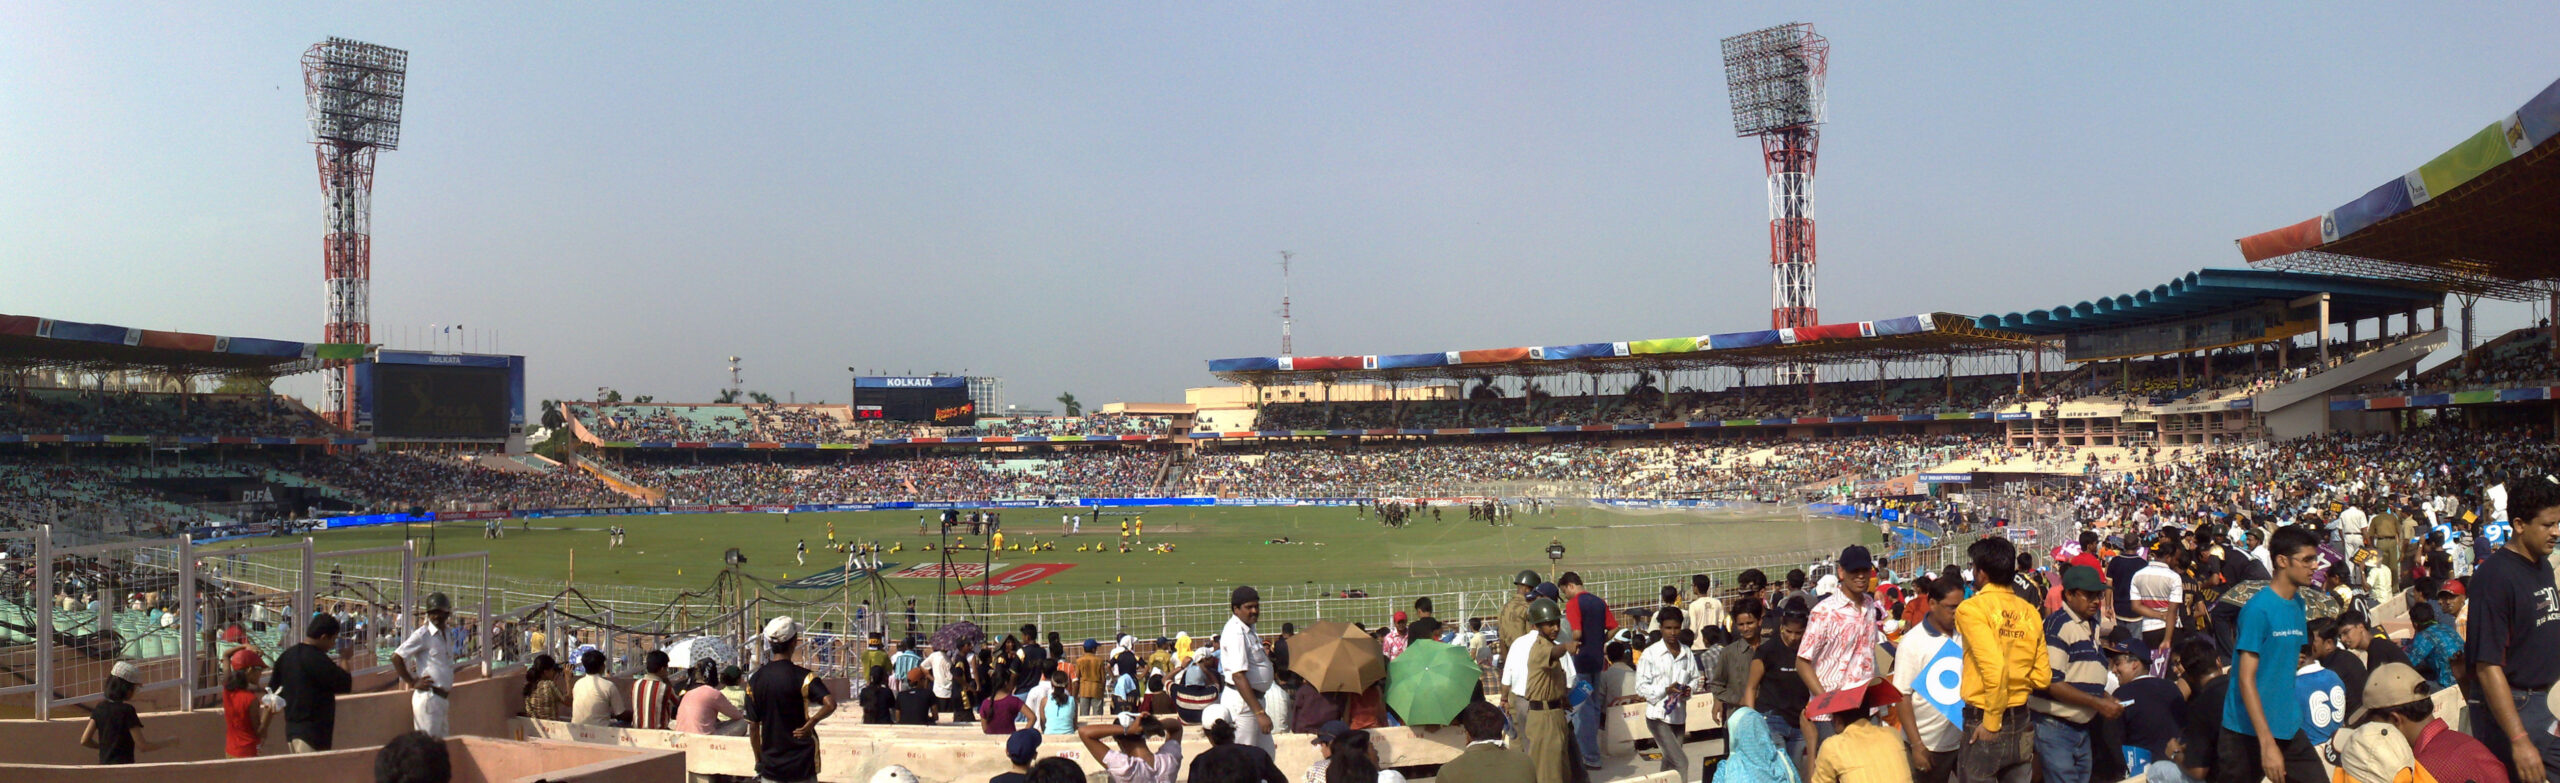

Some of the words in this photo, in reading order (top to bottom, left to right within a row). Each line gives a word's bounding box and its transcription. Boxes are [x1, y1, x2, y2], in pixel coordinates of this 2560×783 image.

[428, 356, 461, 364] KOLKATA
[887, 378, 933, 387] KOLKATA
[2309, 685, 2346, 728] 69
